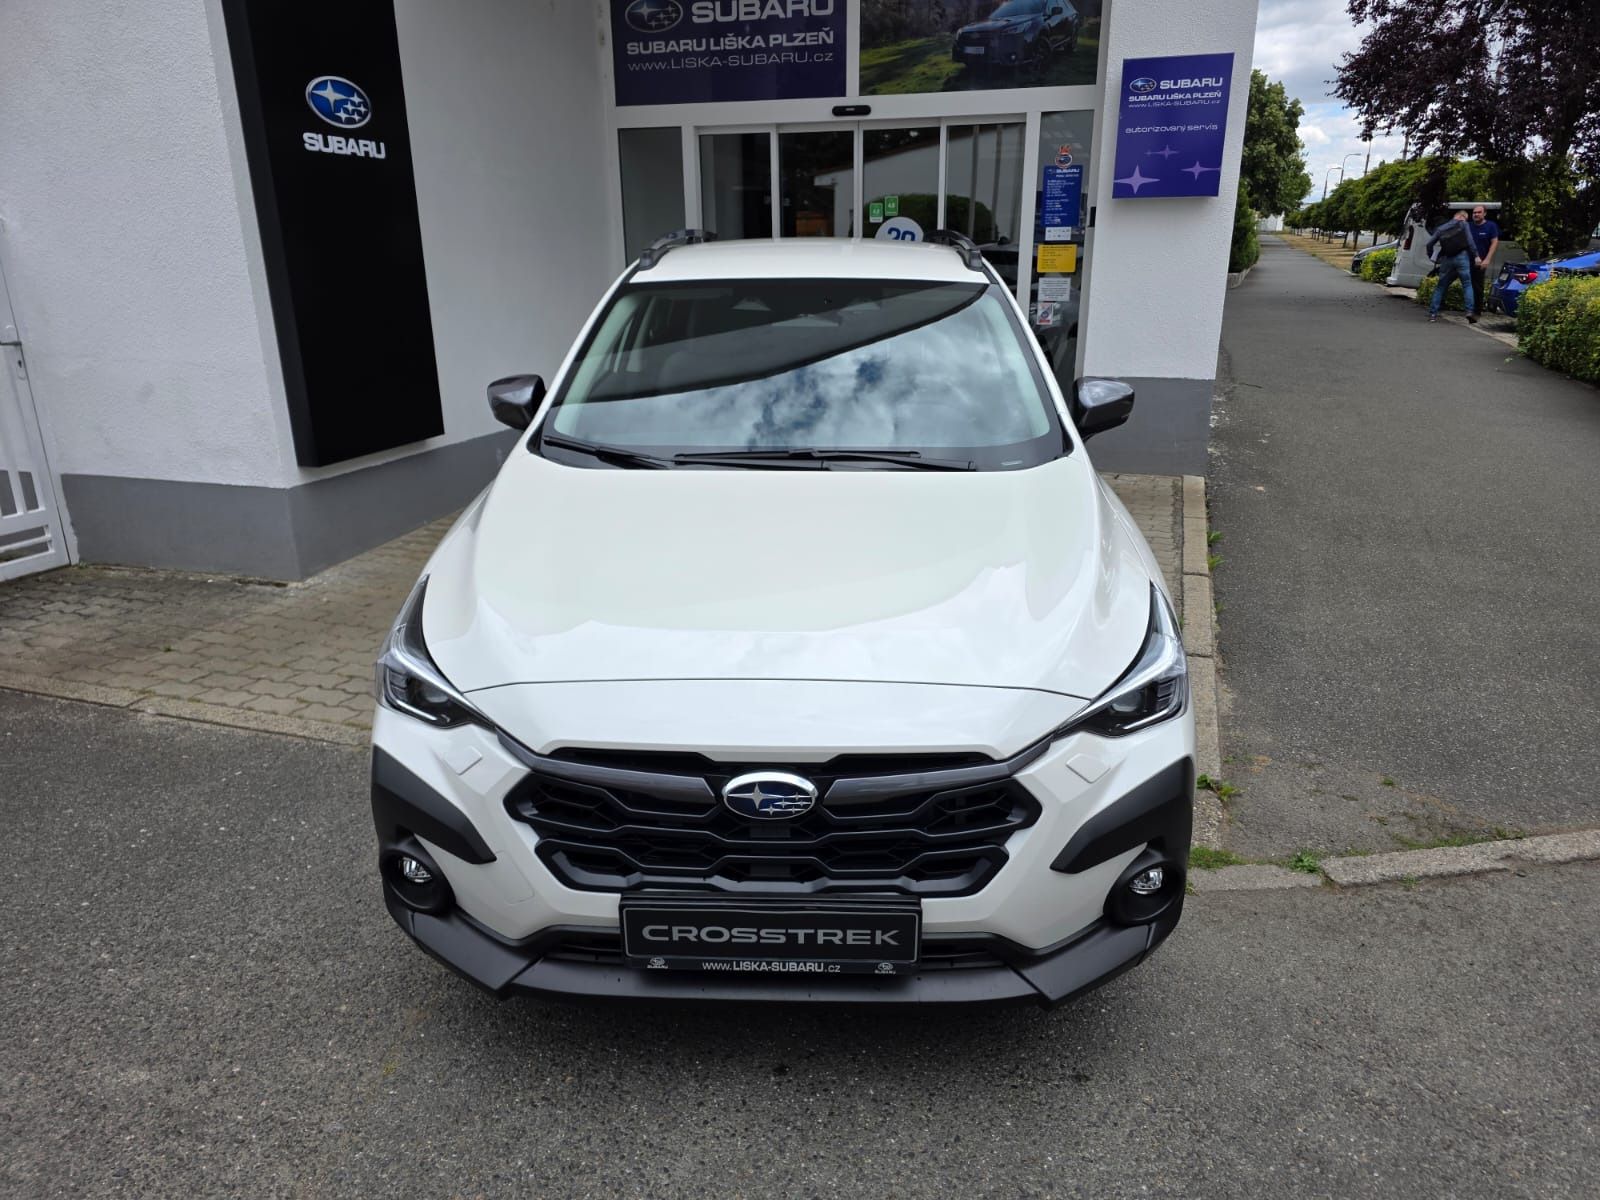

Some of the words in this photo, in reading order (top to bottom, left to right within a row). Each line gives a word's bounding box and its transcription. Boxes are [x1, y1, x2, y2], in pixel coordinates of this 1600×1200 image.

[691, 0, 834, 23] SUBARU
[626, 38, 706, 55] SUBARU
[710, 33, 766, 50] LIŠKA
[769, 27, 834, 47] PLZEŇ
[627, 52, 834, 71] www.LISKA-SUBARU.cz
[1159, 77, 1223, 90] SUBARU
[1128, 93, 1166, 102] SUBARU
[1166, 92, 1192, 100] LIŠKA
[1192, 89, 1222, 99] PLZEŇ
[303, 132, 386, 159] SUBARU
[641, 925, 900, 946] CROSSTREK
[702, 960, 841, 973] www.LISKA-SUBARU.cz
